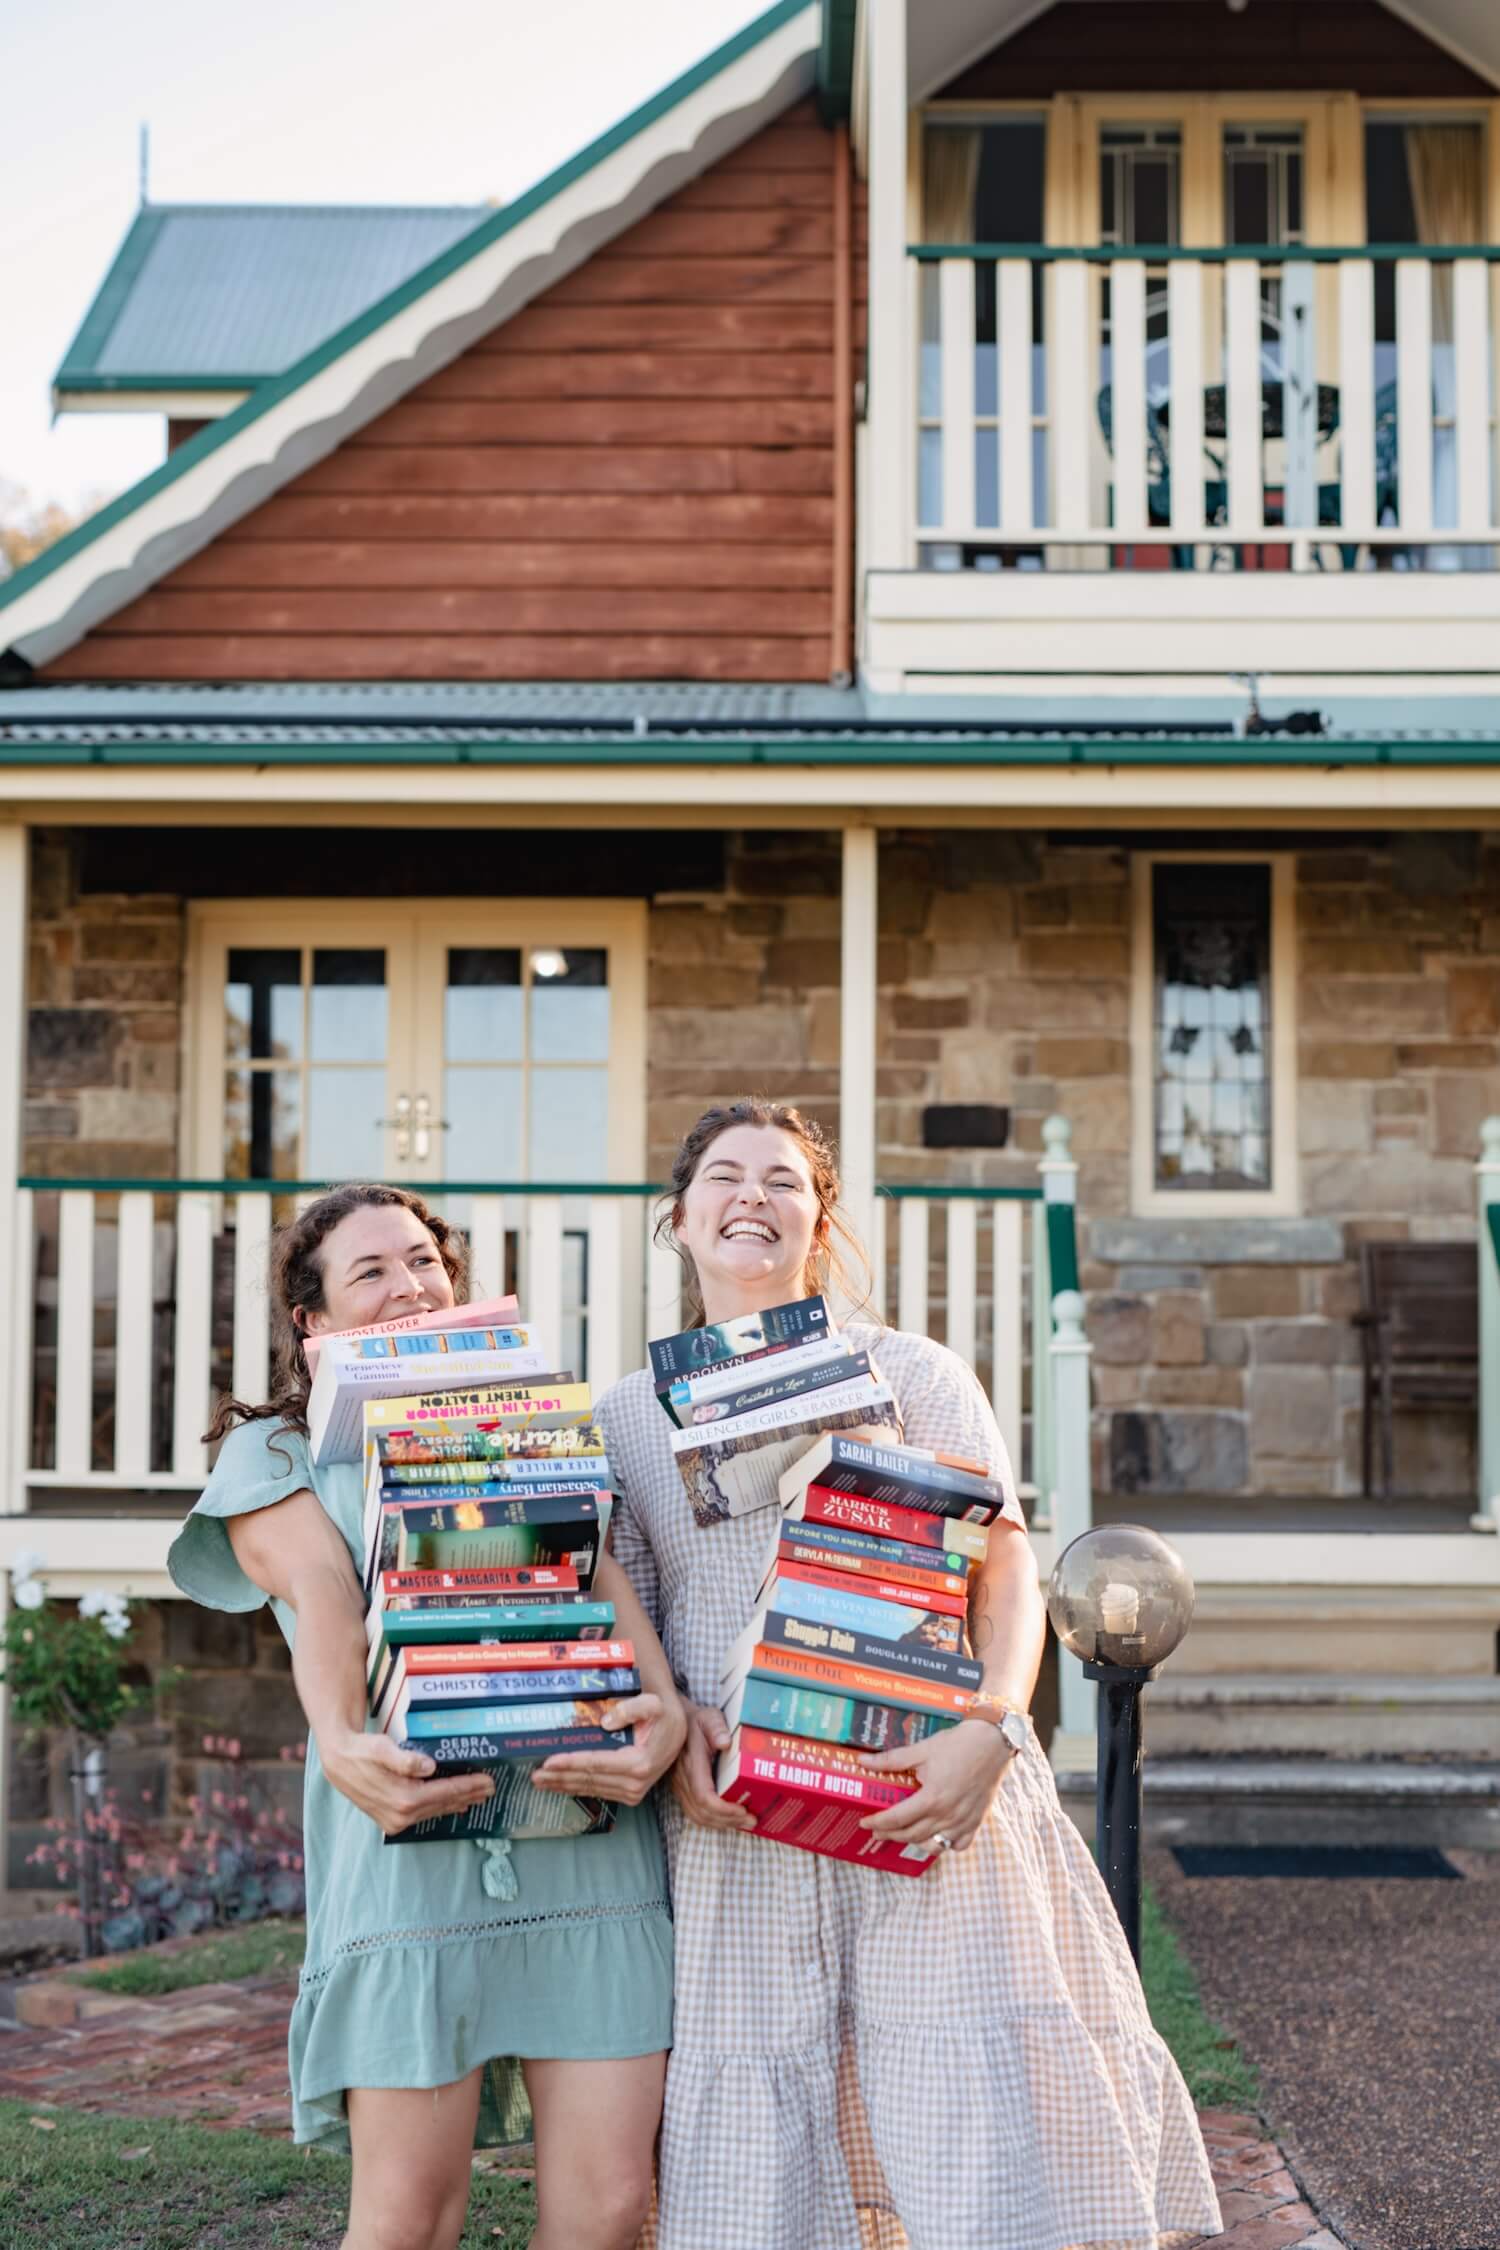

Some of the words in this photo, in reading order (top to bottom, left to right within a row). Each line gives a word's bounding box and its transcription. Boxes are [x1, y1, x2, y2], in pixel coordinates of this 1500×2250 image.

[380, 1319, 420, 1333] LOVER
[659, 1346, 669, 1371] ROBERT
[665, 1343, 677, 1370] JORDAN
[344, 1362, 404, 1372] Genevieve
[674, 1356, 744, 1384] BROOKLYN
[784, 1378, 806, 1391] Love
[420, 1394, 480, 1408] DALTON
[486, 1390, 532, 1402] TRENT
[472, 1404, 498, 1415] THE
[502, 1401, 518, 1413] IN
[522, 1399, 561, 1411] LOLA
[406, 1406, 468, 1420] MIRROR
[687, 1420, 742, 1443] SILENCE
[758, 1406, 798, 1426] GIRLS
[809, 1390, 864, 1413] BARKER
[419, 1434, 481, 1445] THROSBY
[486, 1428, 579, 1452] Clarke
[431, 1444, 472, 1455] HOLLY
[839, 1441, 873, 1465] SARAH
[875, 1451, 910, 1474] BAILEY
[408, 1464, 457, 1478] AFFAIR
[517, 1462, 563, 1473] MILLER
[568, 1461, 597, 1471] ALEX
[400, 1488, 430, 1498] Time
[465, 1486, 488, 1497] Old
[499, 1482, 534, 1495] Barry
[537, 1480, 600, 1493] Sebastian
[829, 1494, 889, 1516] MARKUS
[823, 1503, 893, 1531] ZUSAK
[789, 1526, 820, 1539] BEFORE
[822, 1533, 840, 1542] YOU
[841, 1537, 865, 1548] KNEW
[866, 1542, 878, 1551] MY
[880, 1544, 902, 1556] NAME
[794, 1546, 823, 1561] DERVLA
[399, 1576, 440, 1587] MASTER
[442, 1574, 455, 1587] &
[456, 1573, 512, 1585] MARGARITA
[784, 1618, 829, 1647] Shuggie
[830, 1628, 856, 1654] Bain
[865, 1645, 909, 1662] DOUGLAS
[911, 1657, 948, 1672] STUART
[412, 1653, 456, 1662] Something
[457, 1651, 473, 1660] Bad
[482, 1650, 507, 1660] Going
[517, 1649, 549, 1659] Happen
[763, 1650, 808, 1672] Burnt
[815, 1663, 842, 1680] Out
[854, 1672, 893, 1689] Victoria
[894, 1682, 945, 1701] Brookman
[422, 1679, 498, 1691] CHRISTOS
[503, 1676, 577, 1688] TSIOLKAS
[440, 1736, 490, 1749] DEBRA
[504, 1740, 522, 1749] THE
[526, 1737, 559, 1747] FAMILY
[562, 1733, 604, 1744] DOCTOR
[771, 1736, 801, 1750] THE
[803, 1742, 831, 1757] SUN
[434, 1745, 498, 1760] OSWALD
[781, 1750, 825, 1767] FIONA
[753, 1758, 775, 1778] THE
[778, 1764, 822, 1789] RABBIT
[824, 1774, 863, 1798] HUTCH
